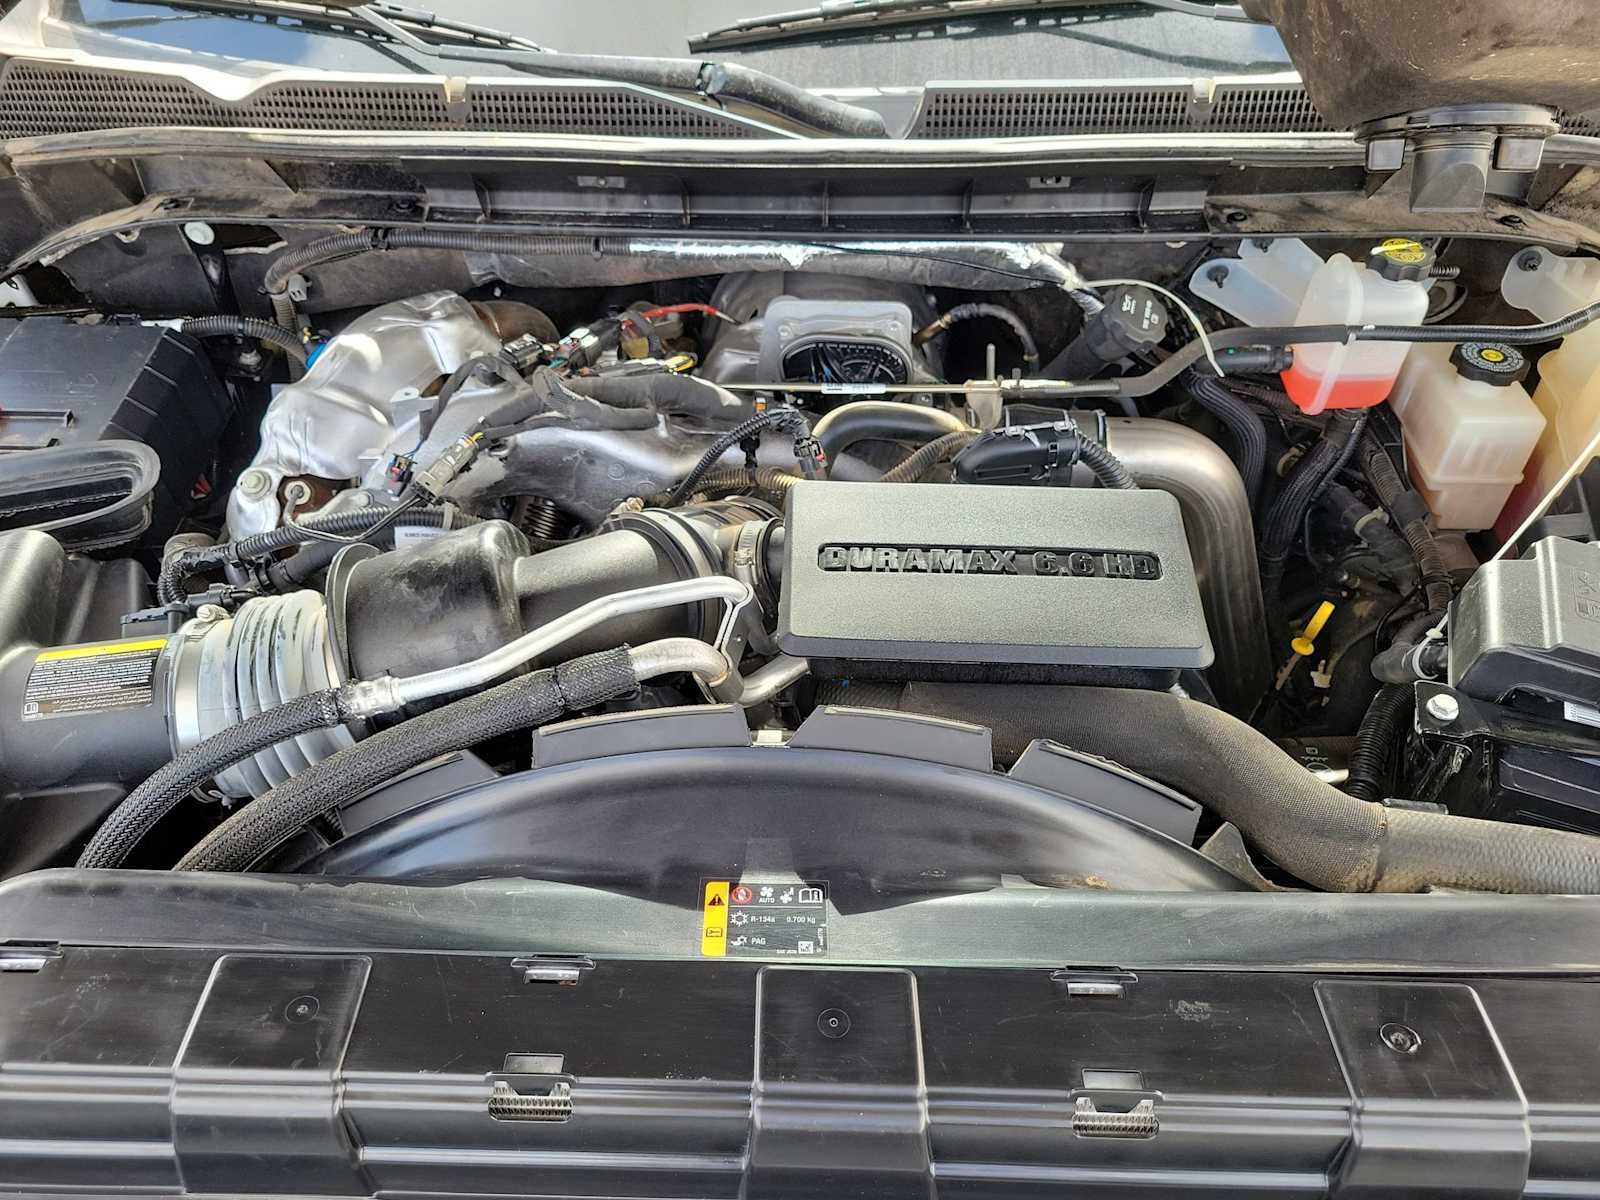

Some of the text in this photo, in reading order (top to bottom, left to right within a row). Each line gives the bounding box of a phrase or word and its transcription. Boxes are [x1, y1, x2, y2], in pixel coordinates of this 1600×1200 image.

[821, 546, 1160, 580] DURAMAX 6.6 HD
[758, 896, 775, 904] AUTO
[750, 915, 776, 924] R-134a
[786, 915, 806, 924] 0.700
[751, 937, 766, 945] PAG
